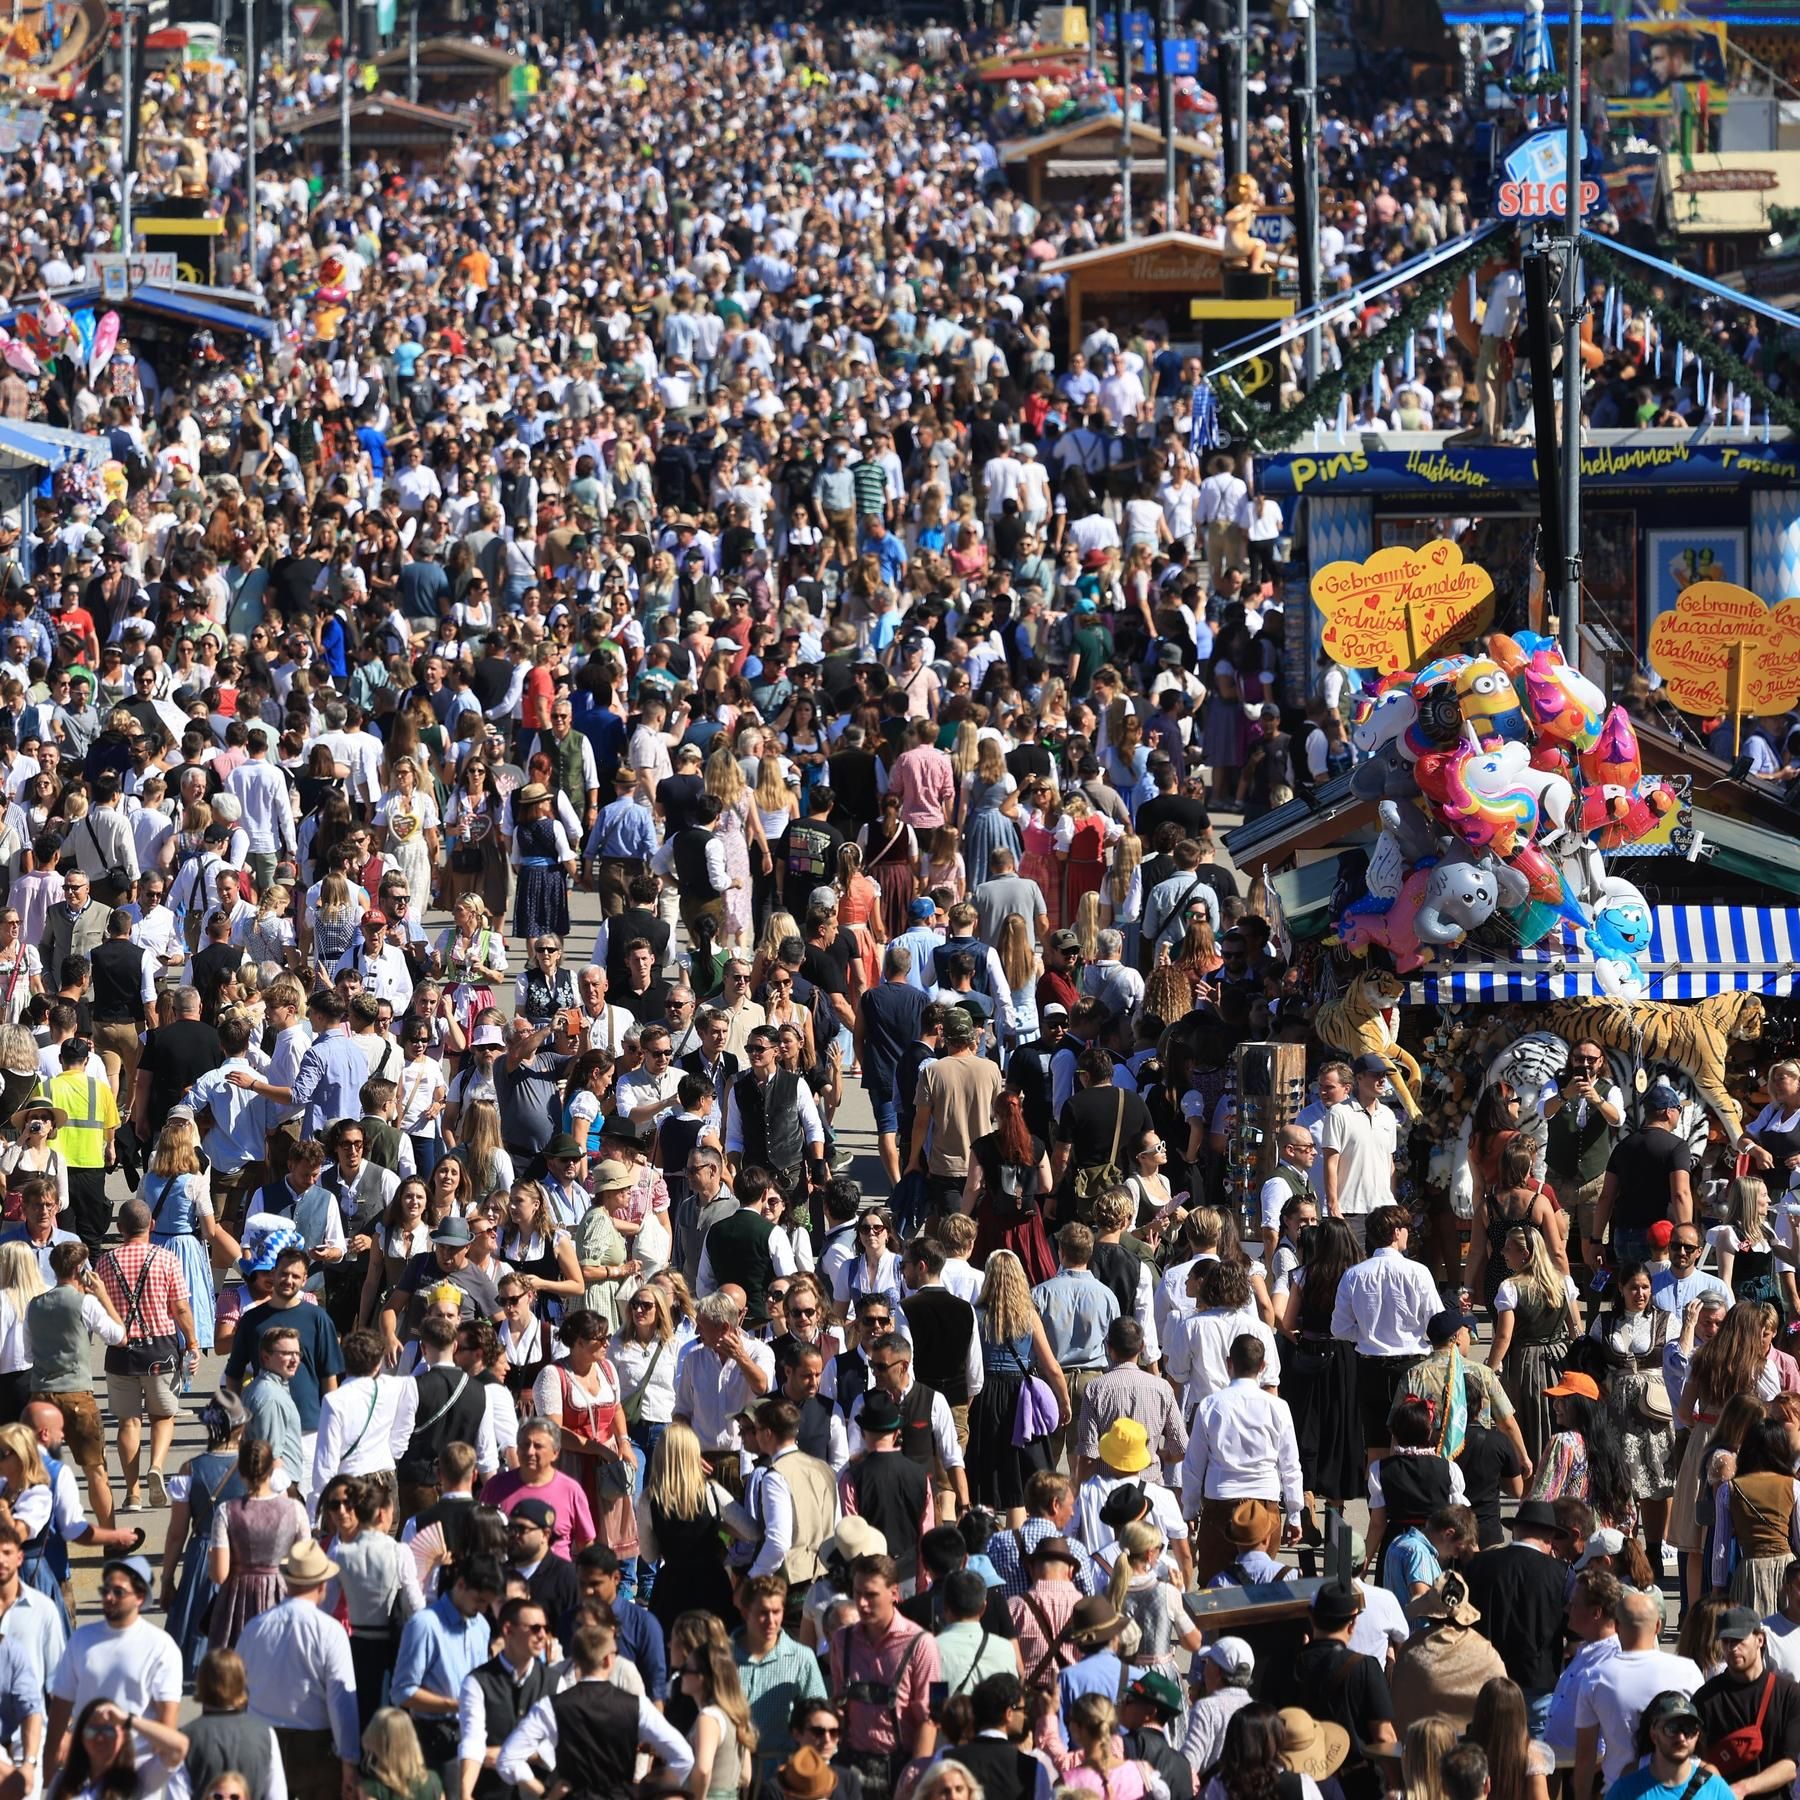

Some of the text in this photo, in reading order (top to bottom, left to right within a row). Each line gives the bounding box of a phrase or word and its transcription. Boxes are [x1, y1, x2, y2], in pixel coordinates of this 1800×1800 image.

[1251, 220, 1281, 237] WC
[1290, 449, 1369, 492] Pins
[1406, 449, 1490, 487] Halstücher
[1721, 448, 1796, 478] Tassen
[1325, 561, 1422, 593] Gebrannte
[1395, 571, 1480, 603] Mandeln
[1681, 595, 1763, 618] Gebrannte
[1661, 615, 1769, 637] Macadamia
[1342, 634, 1393, 658] Para
[1655, 639, 1734, 670] Walnüsse
[1671, 677, 1724, 705] Kürbis
